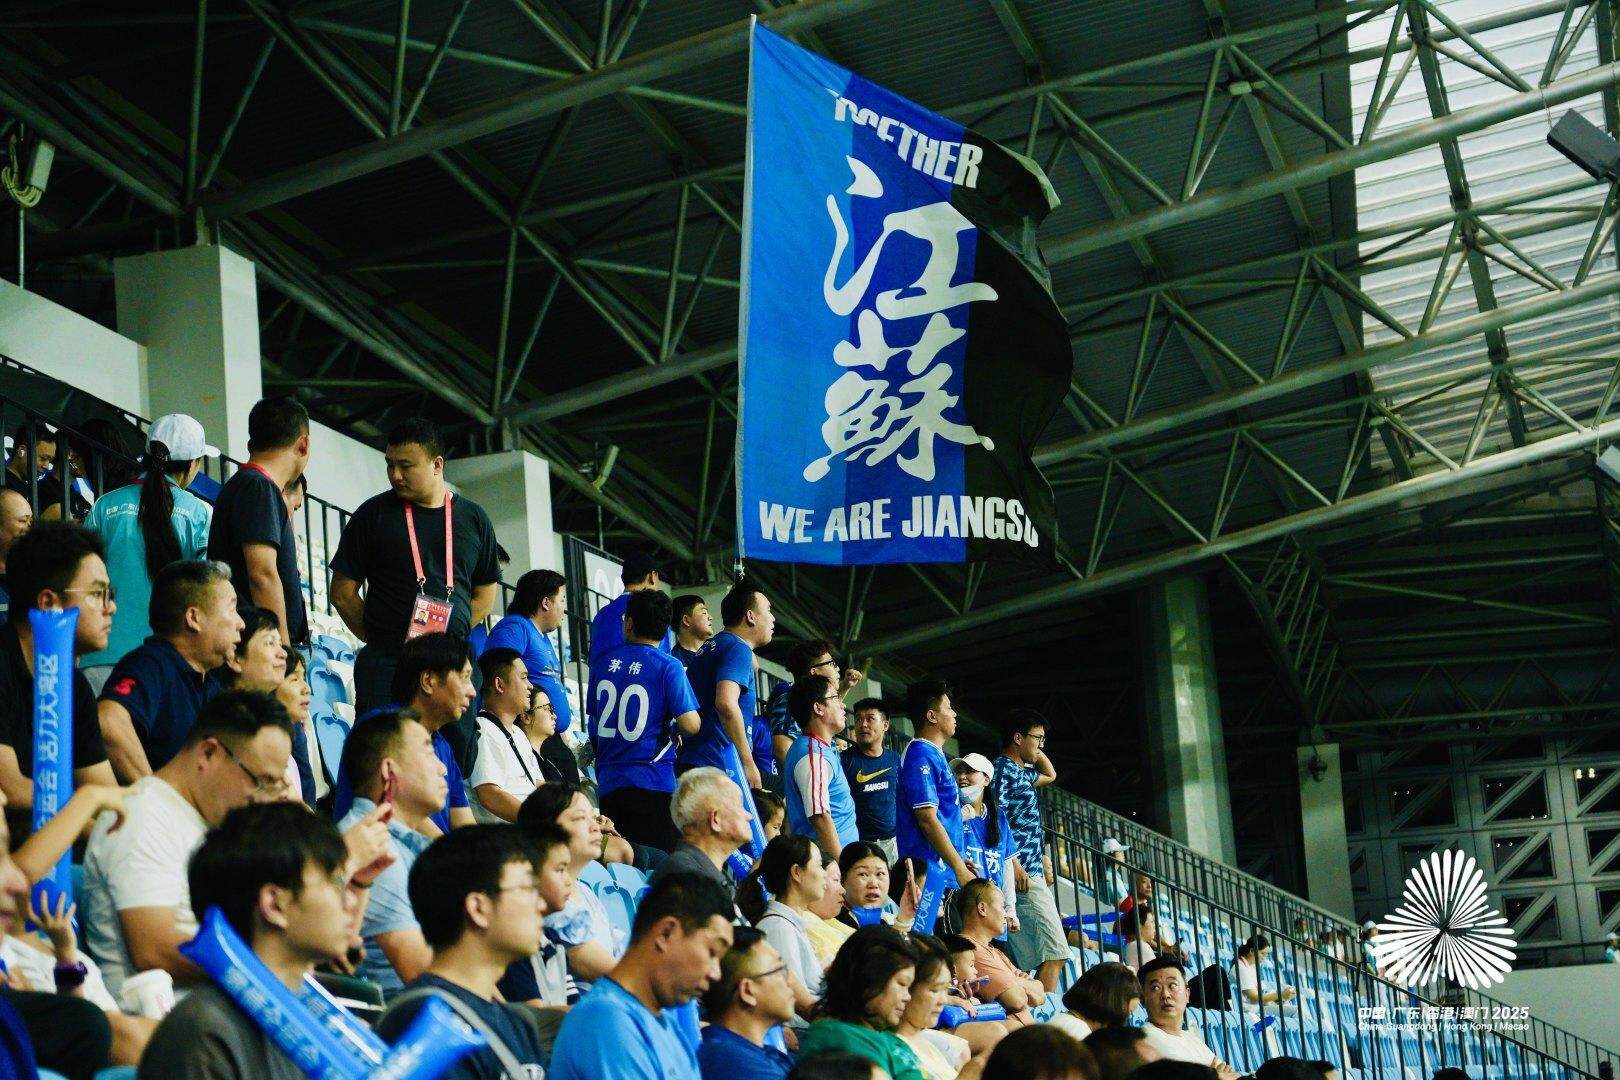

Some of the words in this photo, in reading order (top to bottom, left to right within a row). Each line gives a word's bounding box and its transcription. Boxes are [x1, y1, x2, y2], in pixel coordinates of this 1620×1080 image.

[759, 500, 814, 544] WE
[823, 498, 892, 542] ARE
[38, 654, 59, 763] 活力大湾区
[596, 680, 650, 741] 20
[863, 781, 889, 792] JIANGSU
